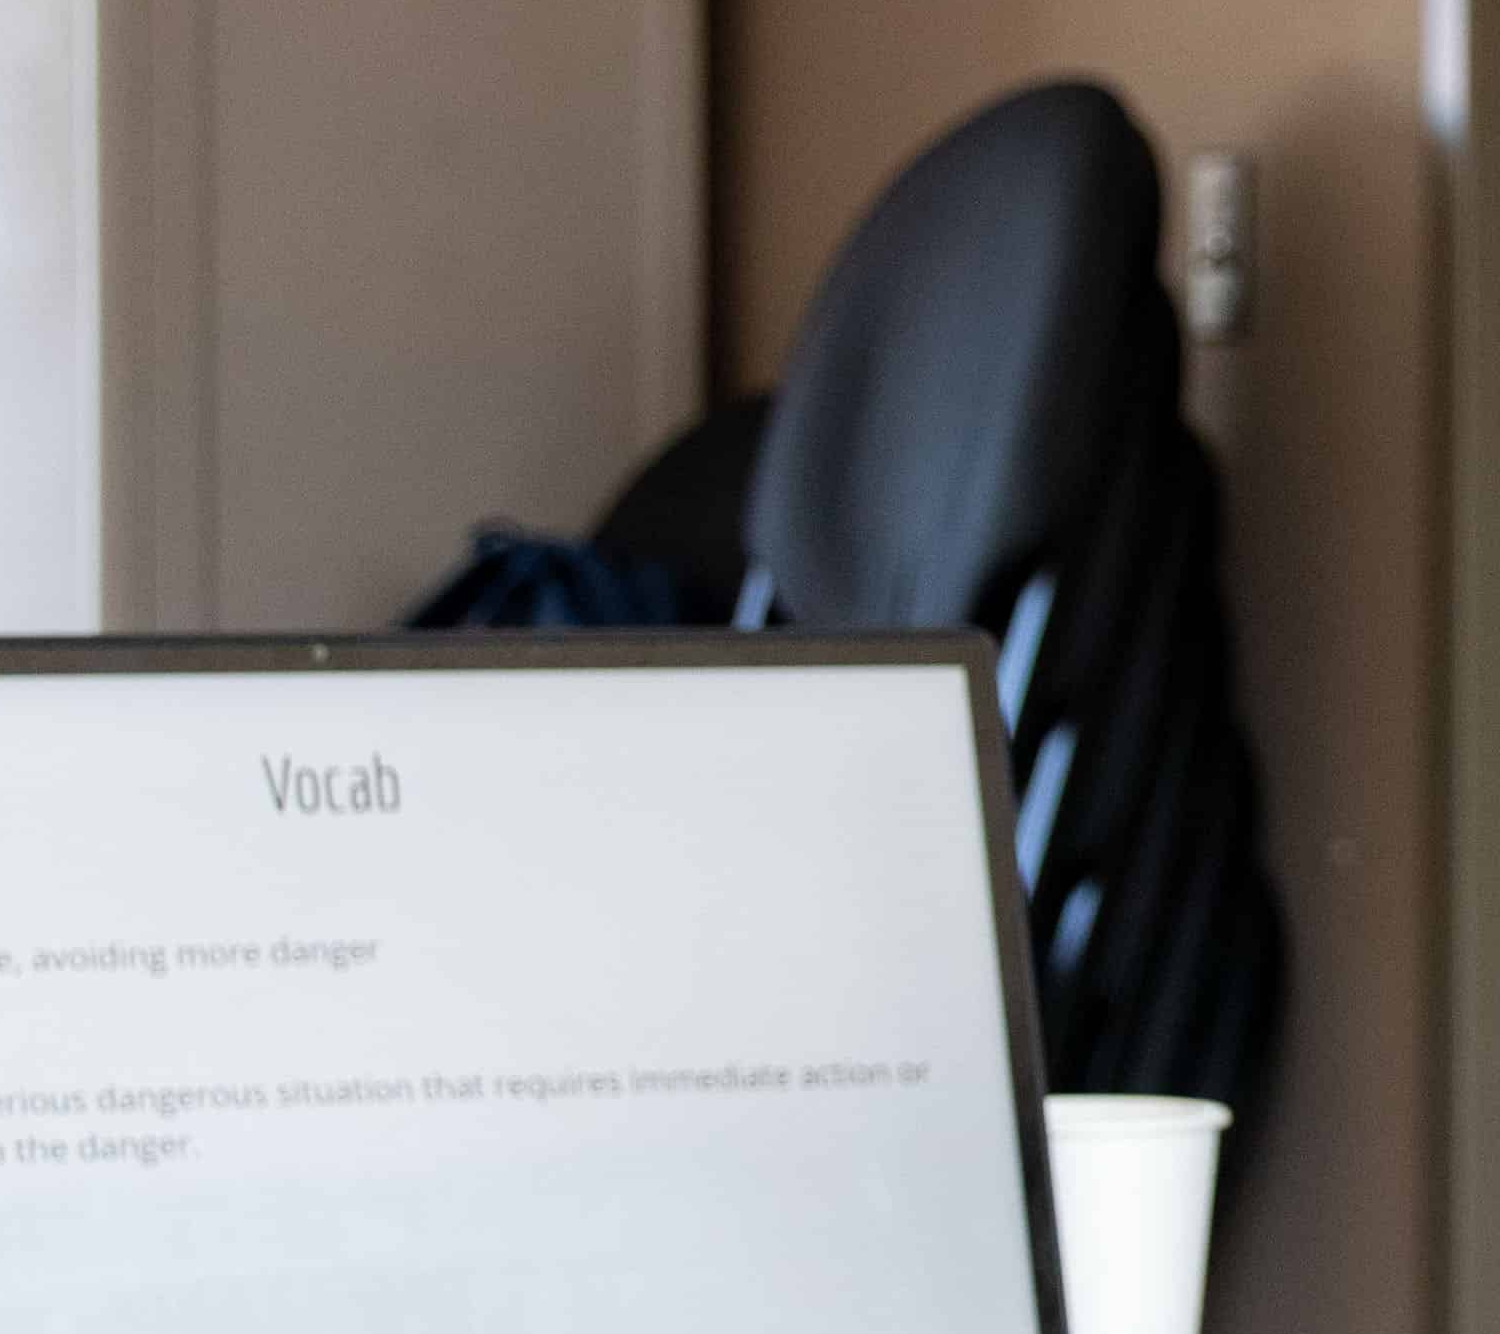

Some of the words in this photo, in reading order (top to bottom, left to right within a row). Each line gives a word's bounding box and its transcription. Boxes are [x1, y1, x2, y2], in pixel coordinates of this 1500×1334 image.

[259, 750, 401, 817] Vocab
[32, 940, 168, 977] avoiding
[176, 942, 262, 967] more
[269, 935, 378, 971] danger
[96, 1083, 268, 1119] dangerous
[276, 1075, 415, 1108] situation
[420, 1068, 485, 1101] that
[493, 1070, 621, 1104] requires
[627, 1061, 790, 1092] immediate
[800, 1060, 889, 1087] action
[895, 1061, 930, 1085] or
[13, 1134, 68, 1164] the
